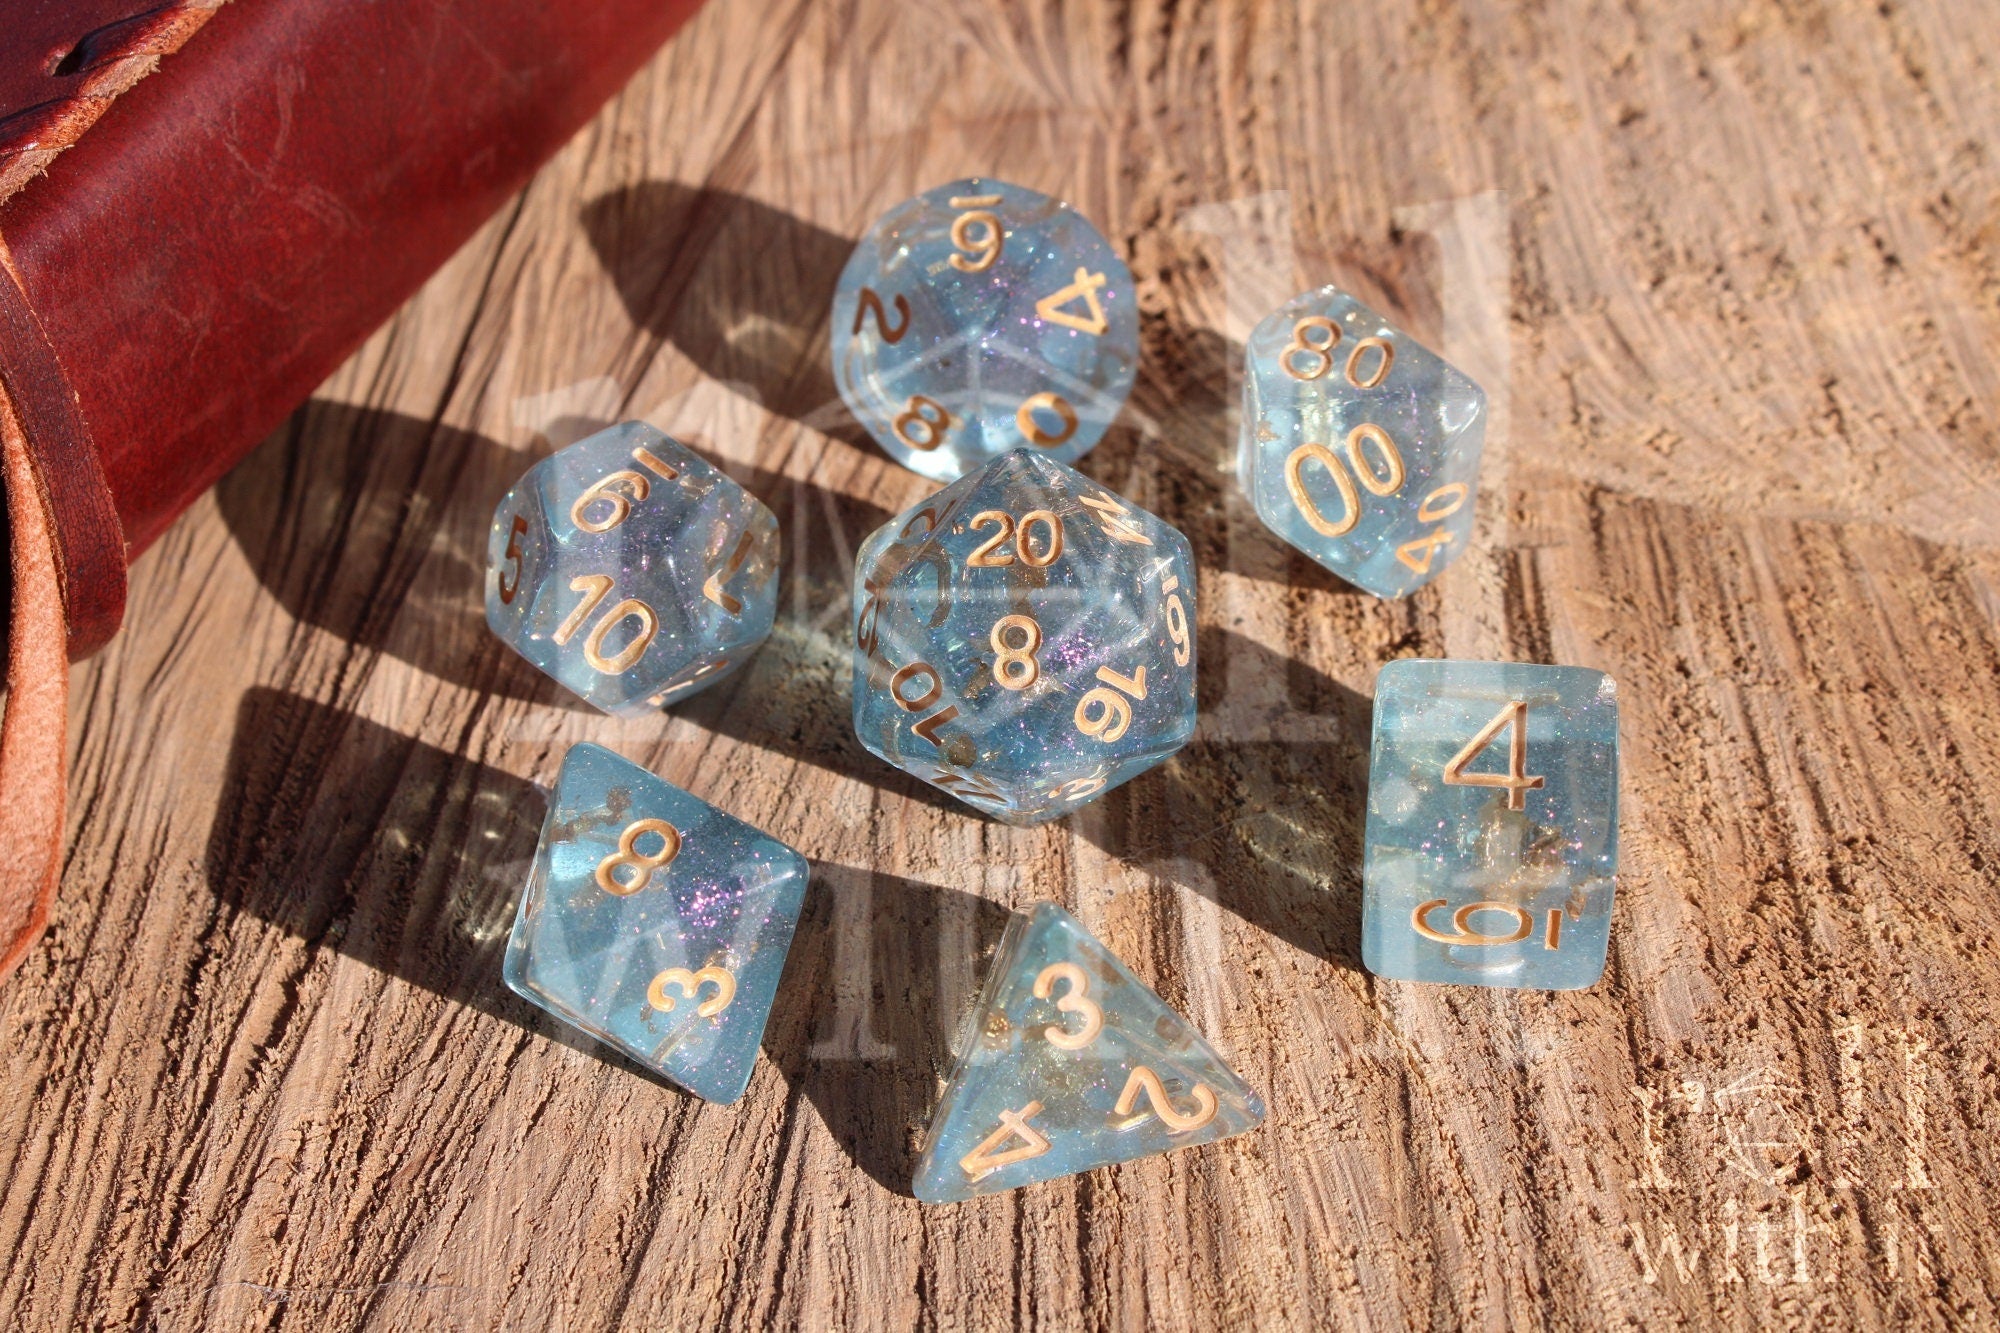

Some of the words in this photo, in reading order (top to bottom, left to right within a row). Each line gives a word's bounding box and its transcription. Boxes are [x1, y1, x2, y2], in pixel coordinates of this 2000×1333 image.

[853, 287, 911, 345] 2
[1035, 267, 1108, 336] 4
[1278, 315, 1396, 390] 80
[892, 395, 950, 452] 8
[1016, 392, 1079, 448] 0
[1284, 422, 1406, 538] 00
[498, 514, 528, 605] 5
[966, 509, 1065, 568] 20
[1396, 482, 1469, 575] 40
[552, 574, 659, 676] 10
[990, 614, 1043, 691] 8
[890, 662, 960, 747] 10
[1074, 665, 1148, 743] 16
[1443, 701, 1545, 811] 4
[595, 818, 682, 896] 8
[647, 966, 737, 1018] 3
[1033, 962, 1105, 1050] 3
[1114, 1066, 1219, 1132] 2
[959, 1100, 1052, 1176] 4
